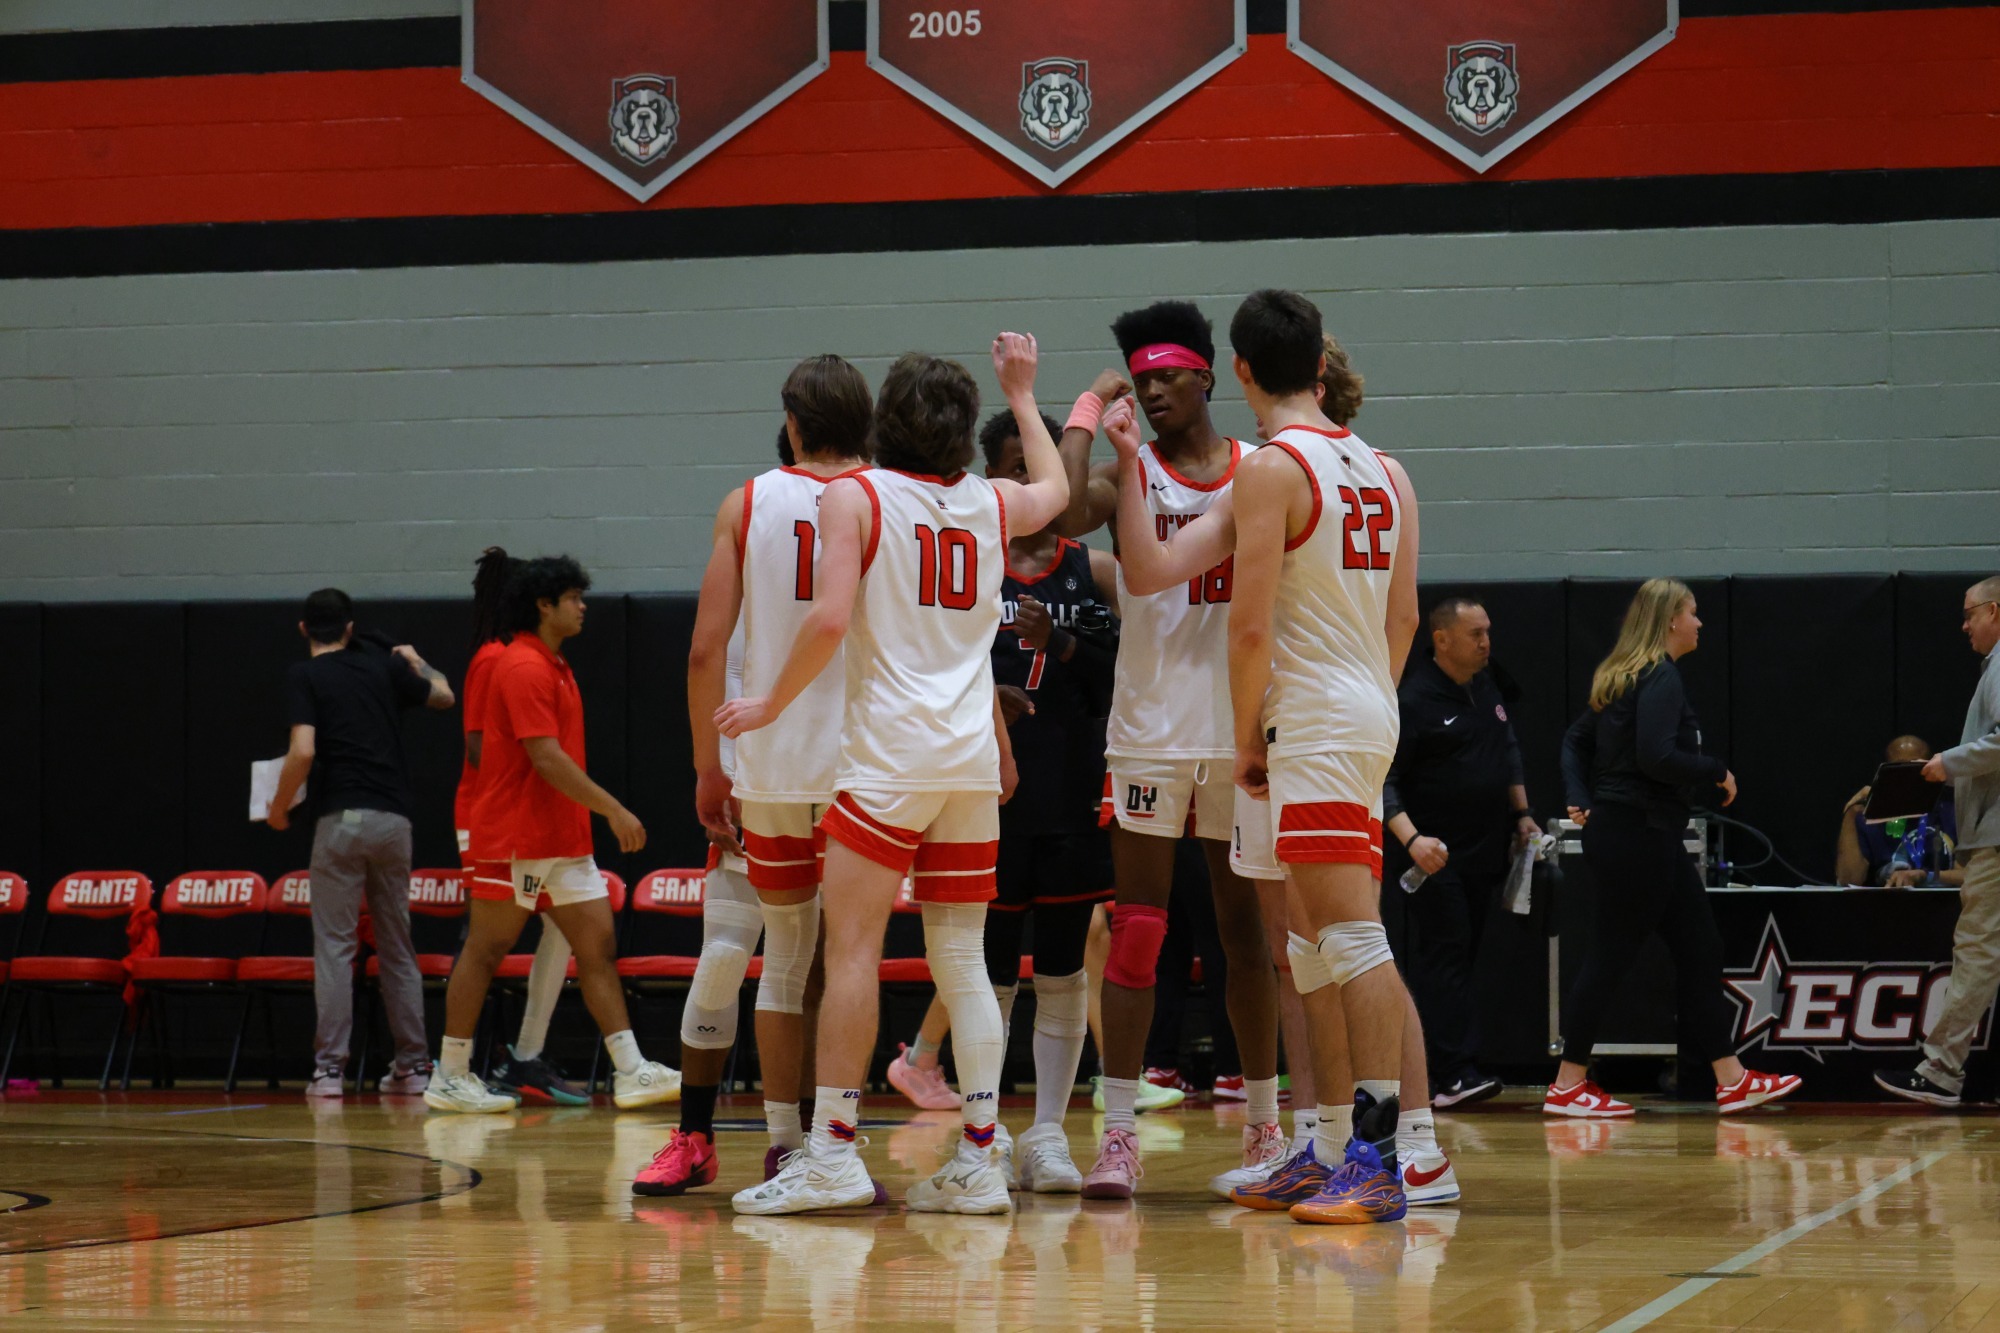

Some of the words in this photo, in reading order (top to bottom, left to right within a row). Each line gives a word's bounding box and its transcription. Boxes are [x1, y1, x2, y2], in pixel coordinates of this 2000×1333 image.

[909, 9, 981, 38] 2005
[1337, 484, 1393, 570] 22
[794, 520, 821, 601] 1
[914, 523, 978, 611] 10
[1018, 638, 1047, 690] 7
[966, 1091, 993, 1102] USA
